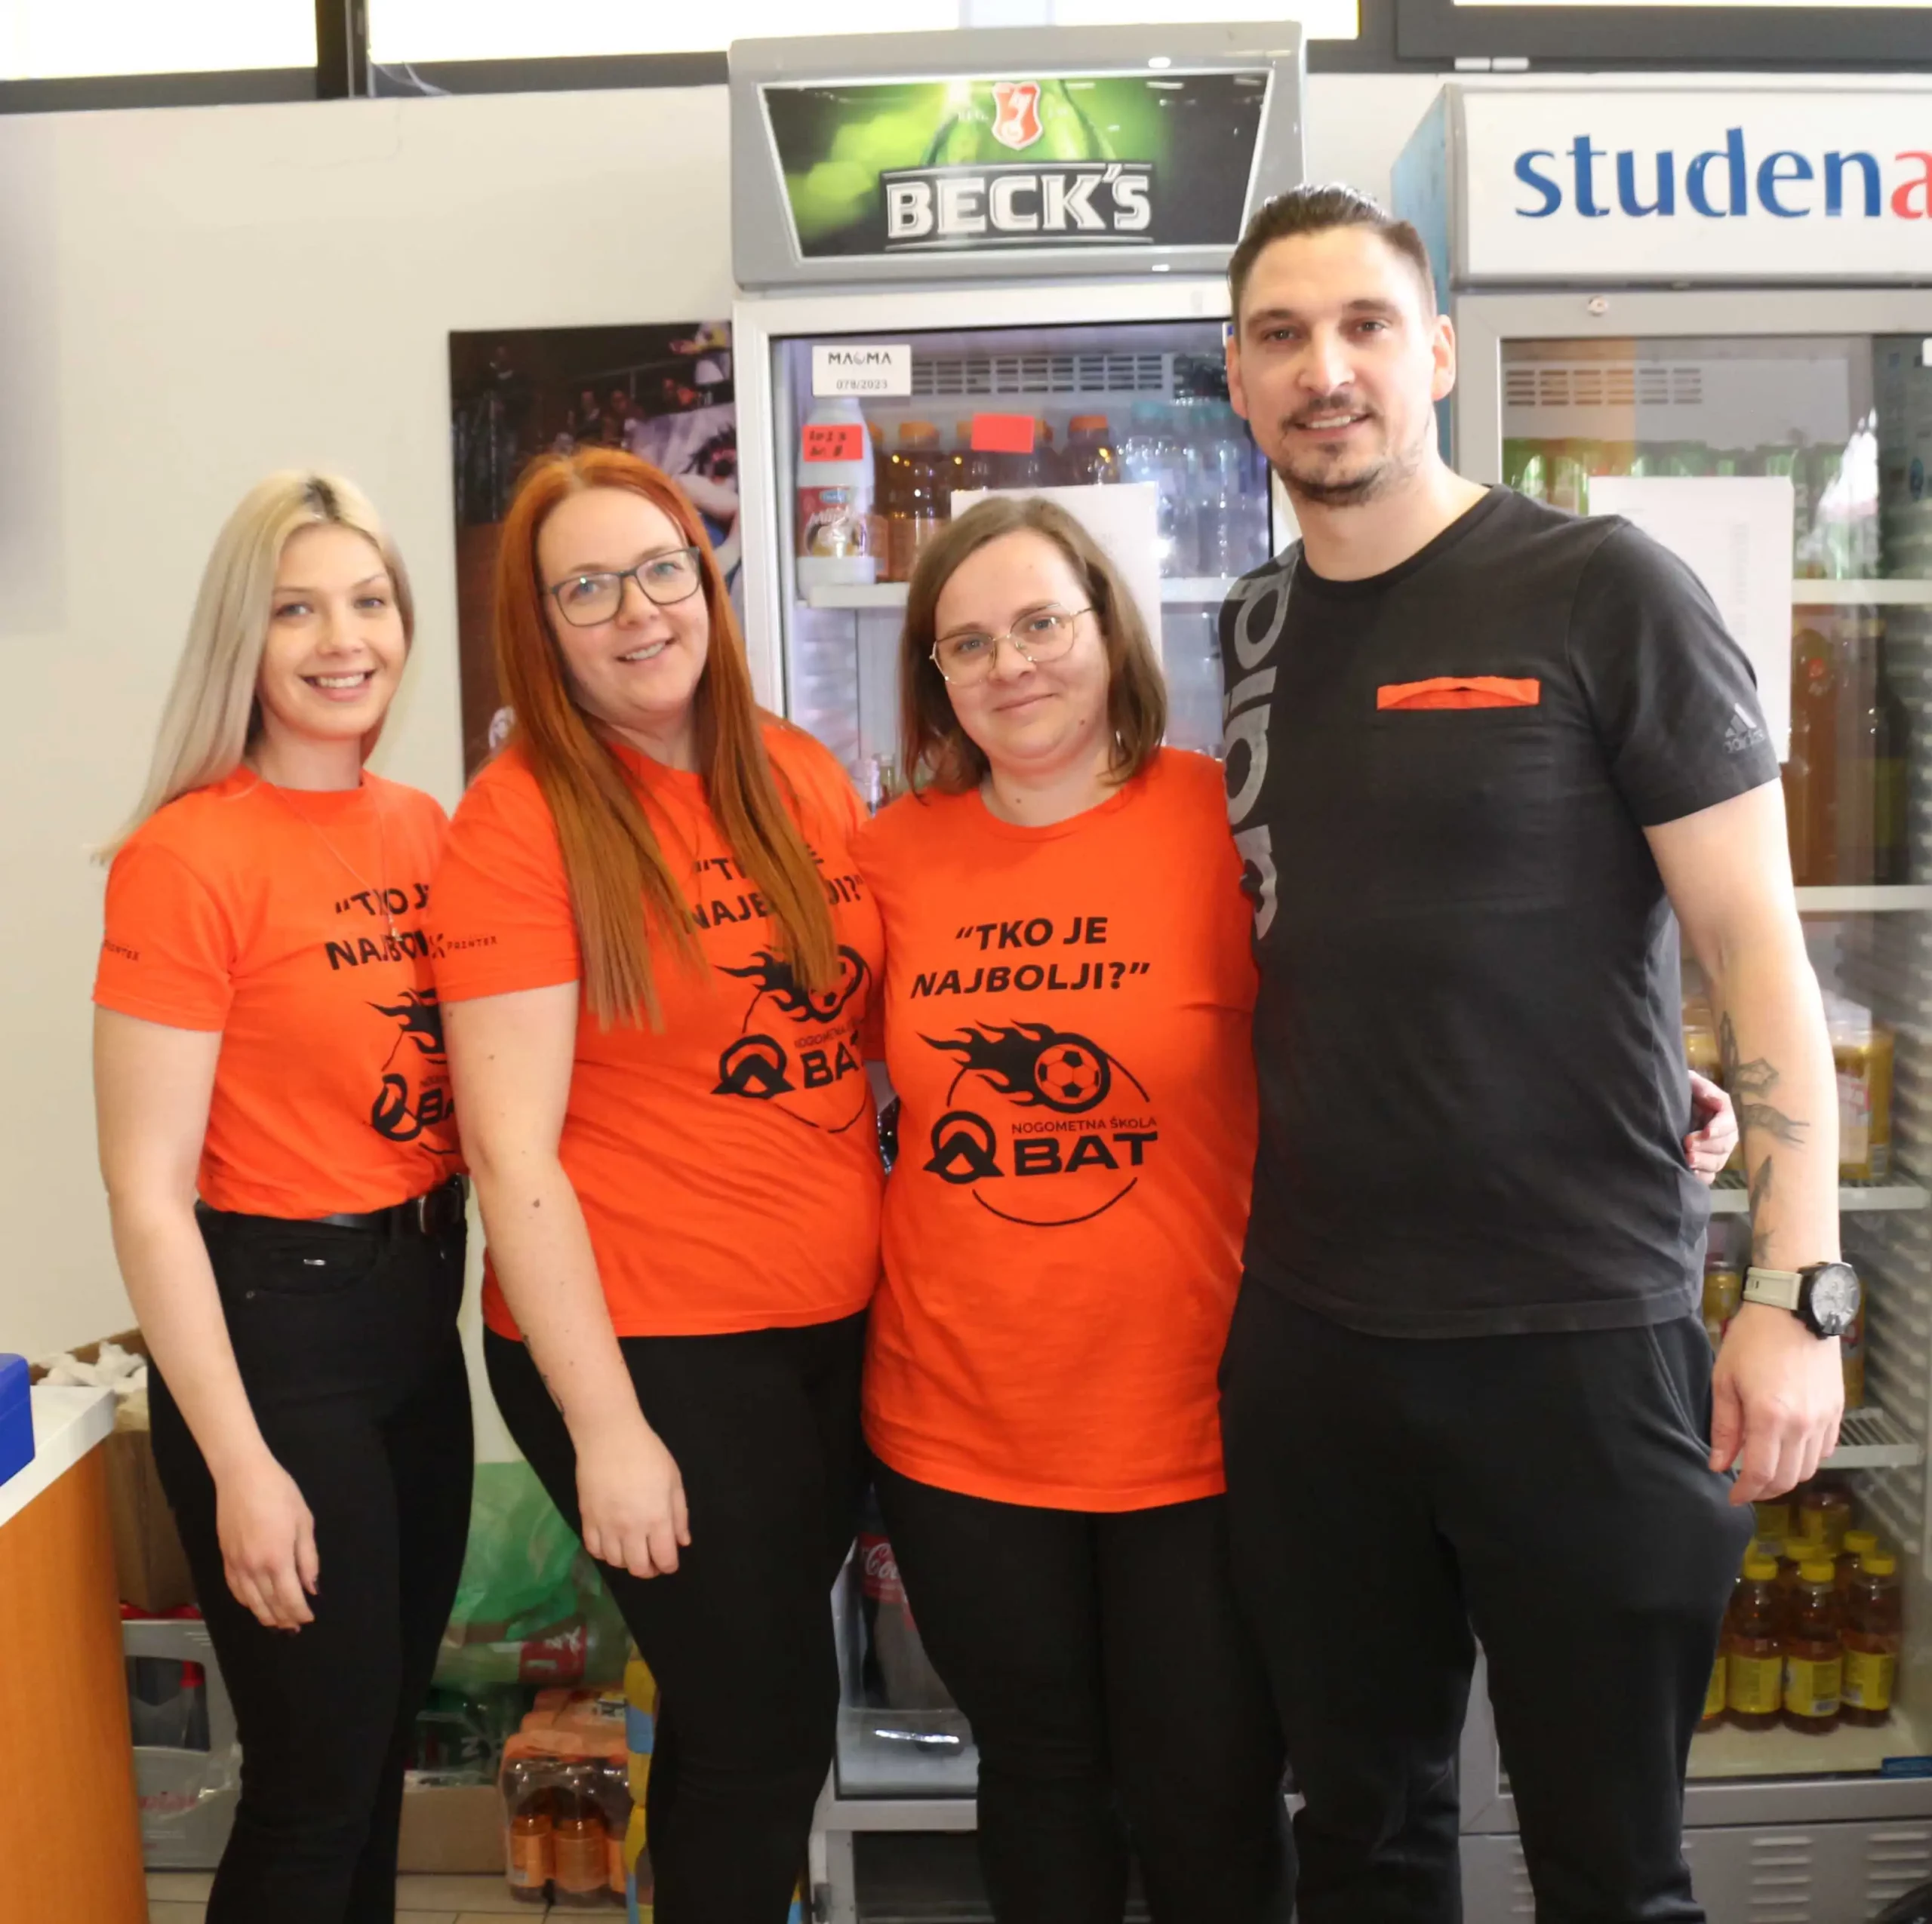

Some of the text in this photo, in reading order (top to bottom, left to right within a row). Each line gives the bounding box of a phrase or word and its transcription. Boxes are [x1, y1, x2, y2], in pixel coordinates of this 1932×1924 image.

[886, 164, 1152, 240] BECK'S
[835, 380, 888, 390] 078/2023
[1063, 917, 1108, 945] JE
[446, 936, 498, 951] PRINTEX
[1011, 1116, 1158, 1134] NOGOMETNA ŠKOLA
[1014, 1132, 1158, 1177] BAT
